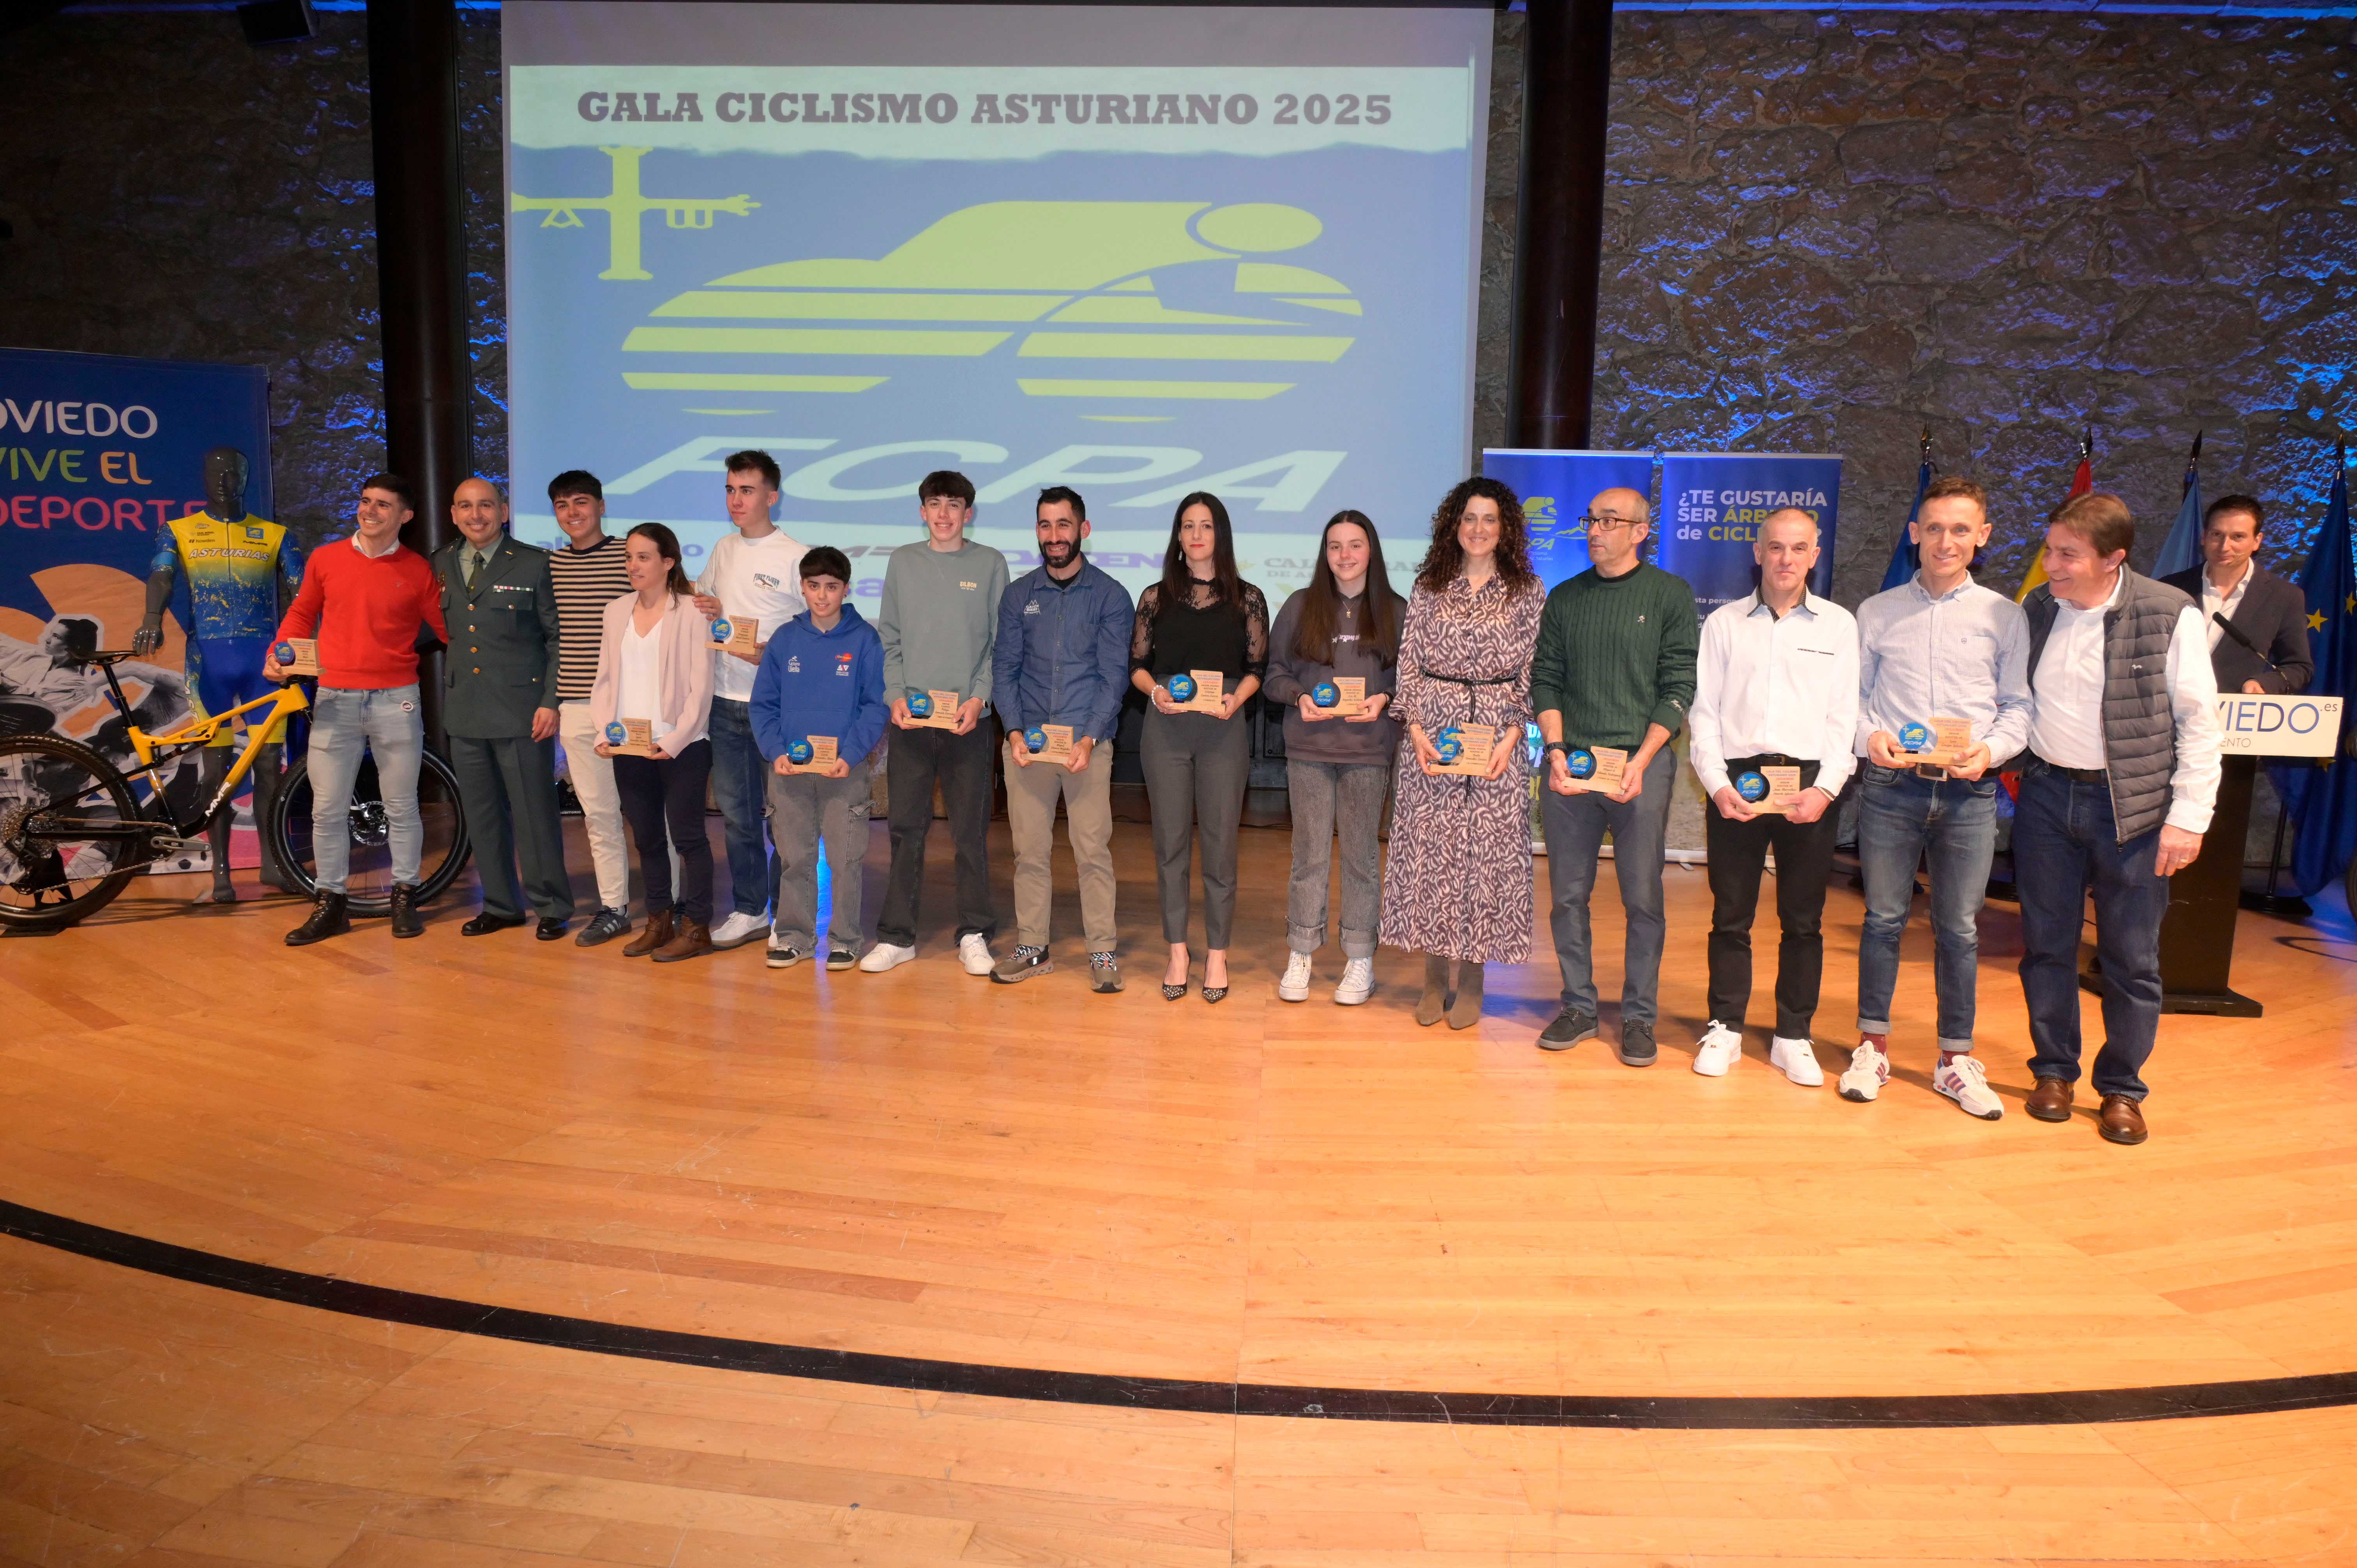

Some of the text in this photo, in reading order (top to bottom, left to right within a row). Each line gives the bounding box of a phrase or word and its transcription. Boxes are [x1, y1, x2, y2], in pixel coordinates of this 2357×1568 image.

[578, 90, 1392, 125] GALA CICLISMO ASTURIANO 2025
[0, 398, 158, 439] VIEDO
[0, 448, 152, 485] IVE EL
[600, 436, 1348, 514] FCPA
[0, 496, 207, 531] EPORT
[1677, 508, 1717, 522] SER
[1679, 488, 1827, 507] ¿TE GUSTARÍA
[1677, 525, 1702, 540] de
[188, 548, 270, 562] ASTURIAS
[2219, 701, 2320, 734] IEDO
[205, 782, 232, 817] MMR
